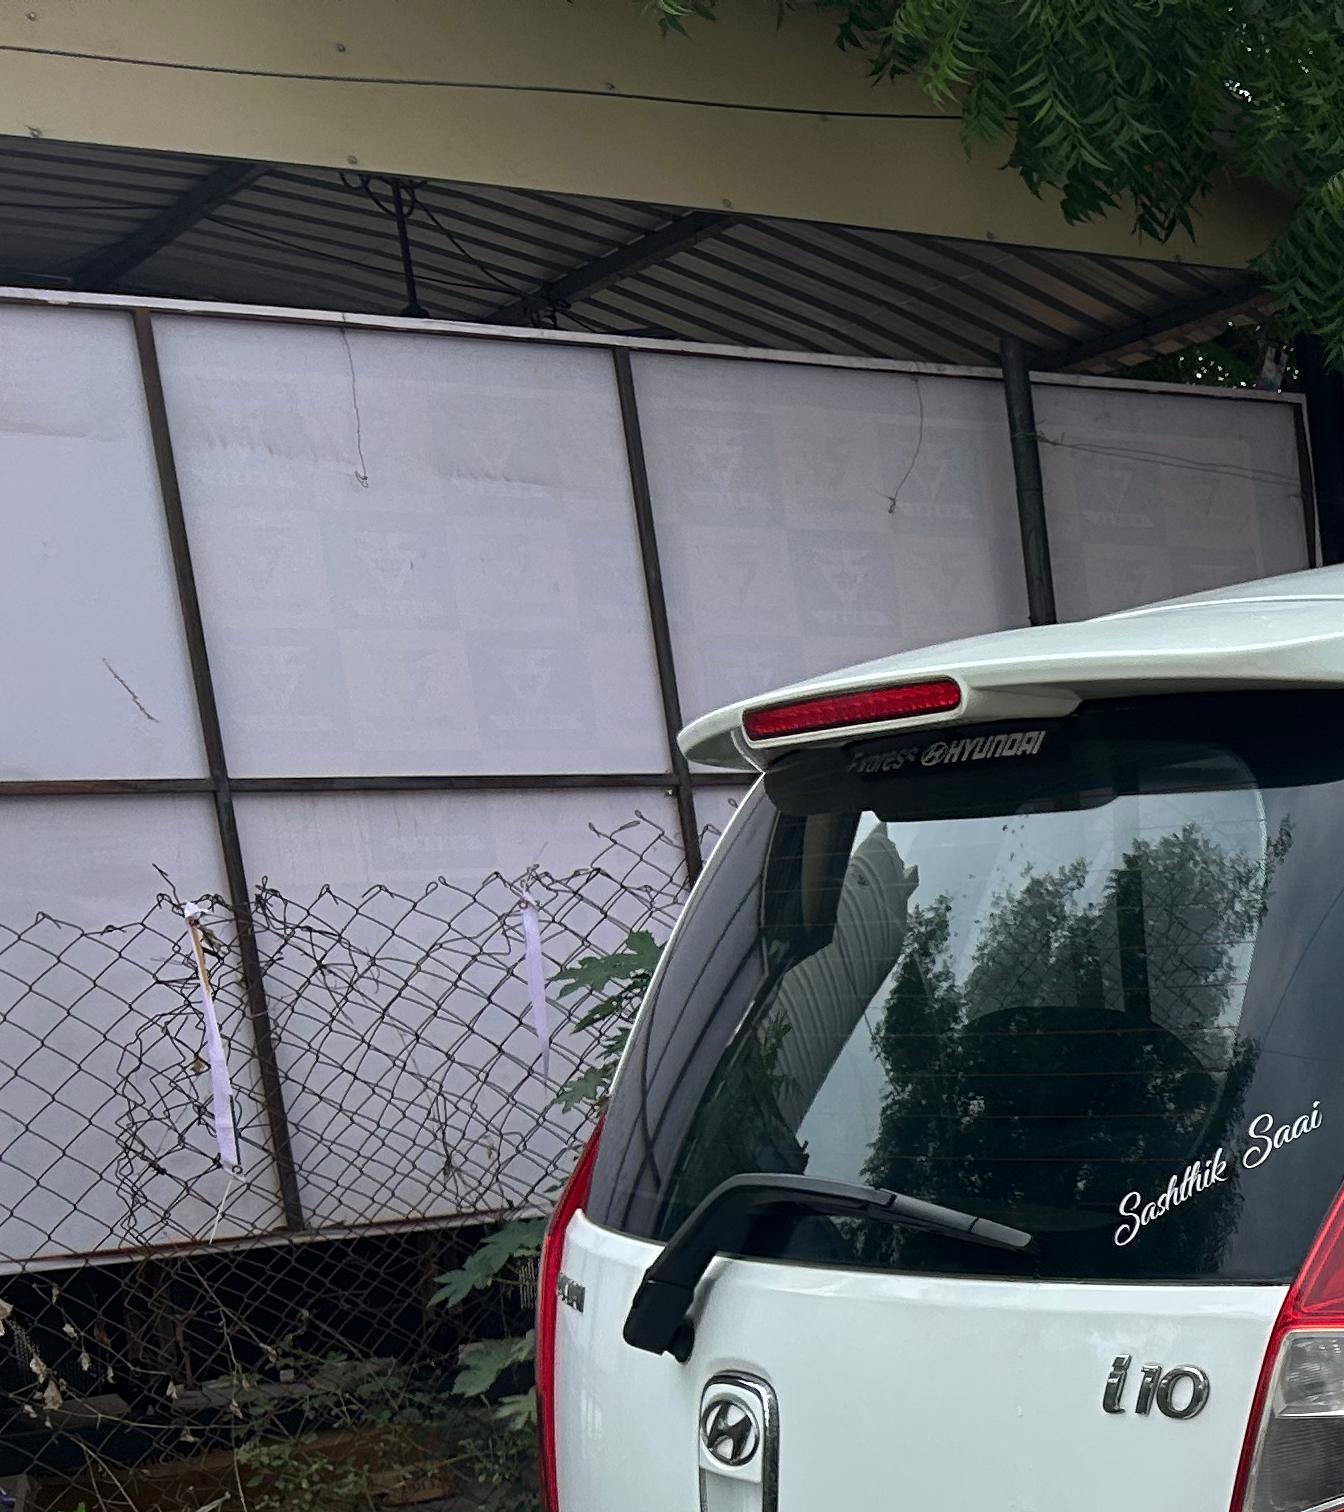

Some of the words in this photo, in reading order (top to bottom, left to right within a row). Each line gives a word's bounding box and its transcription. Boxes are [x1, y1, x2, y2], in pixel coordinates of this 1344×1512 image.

[944, 730, 1046, 764] HYUNDAI
[1113, 1147, 1229, 1247] Sashthik
[1242, 1100, 1323, 1169] Saai
[1102, 1353, 1211, 1421] i10
